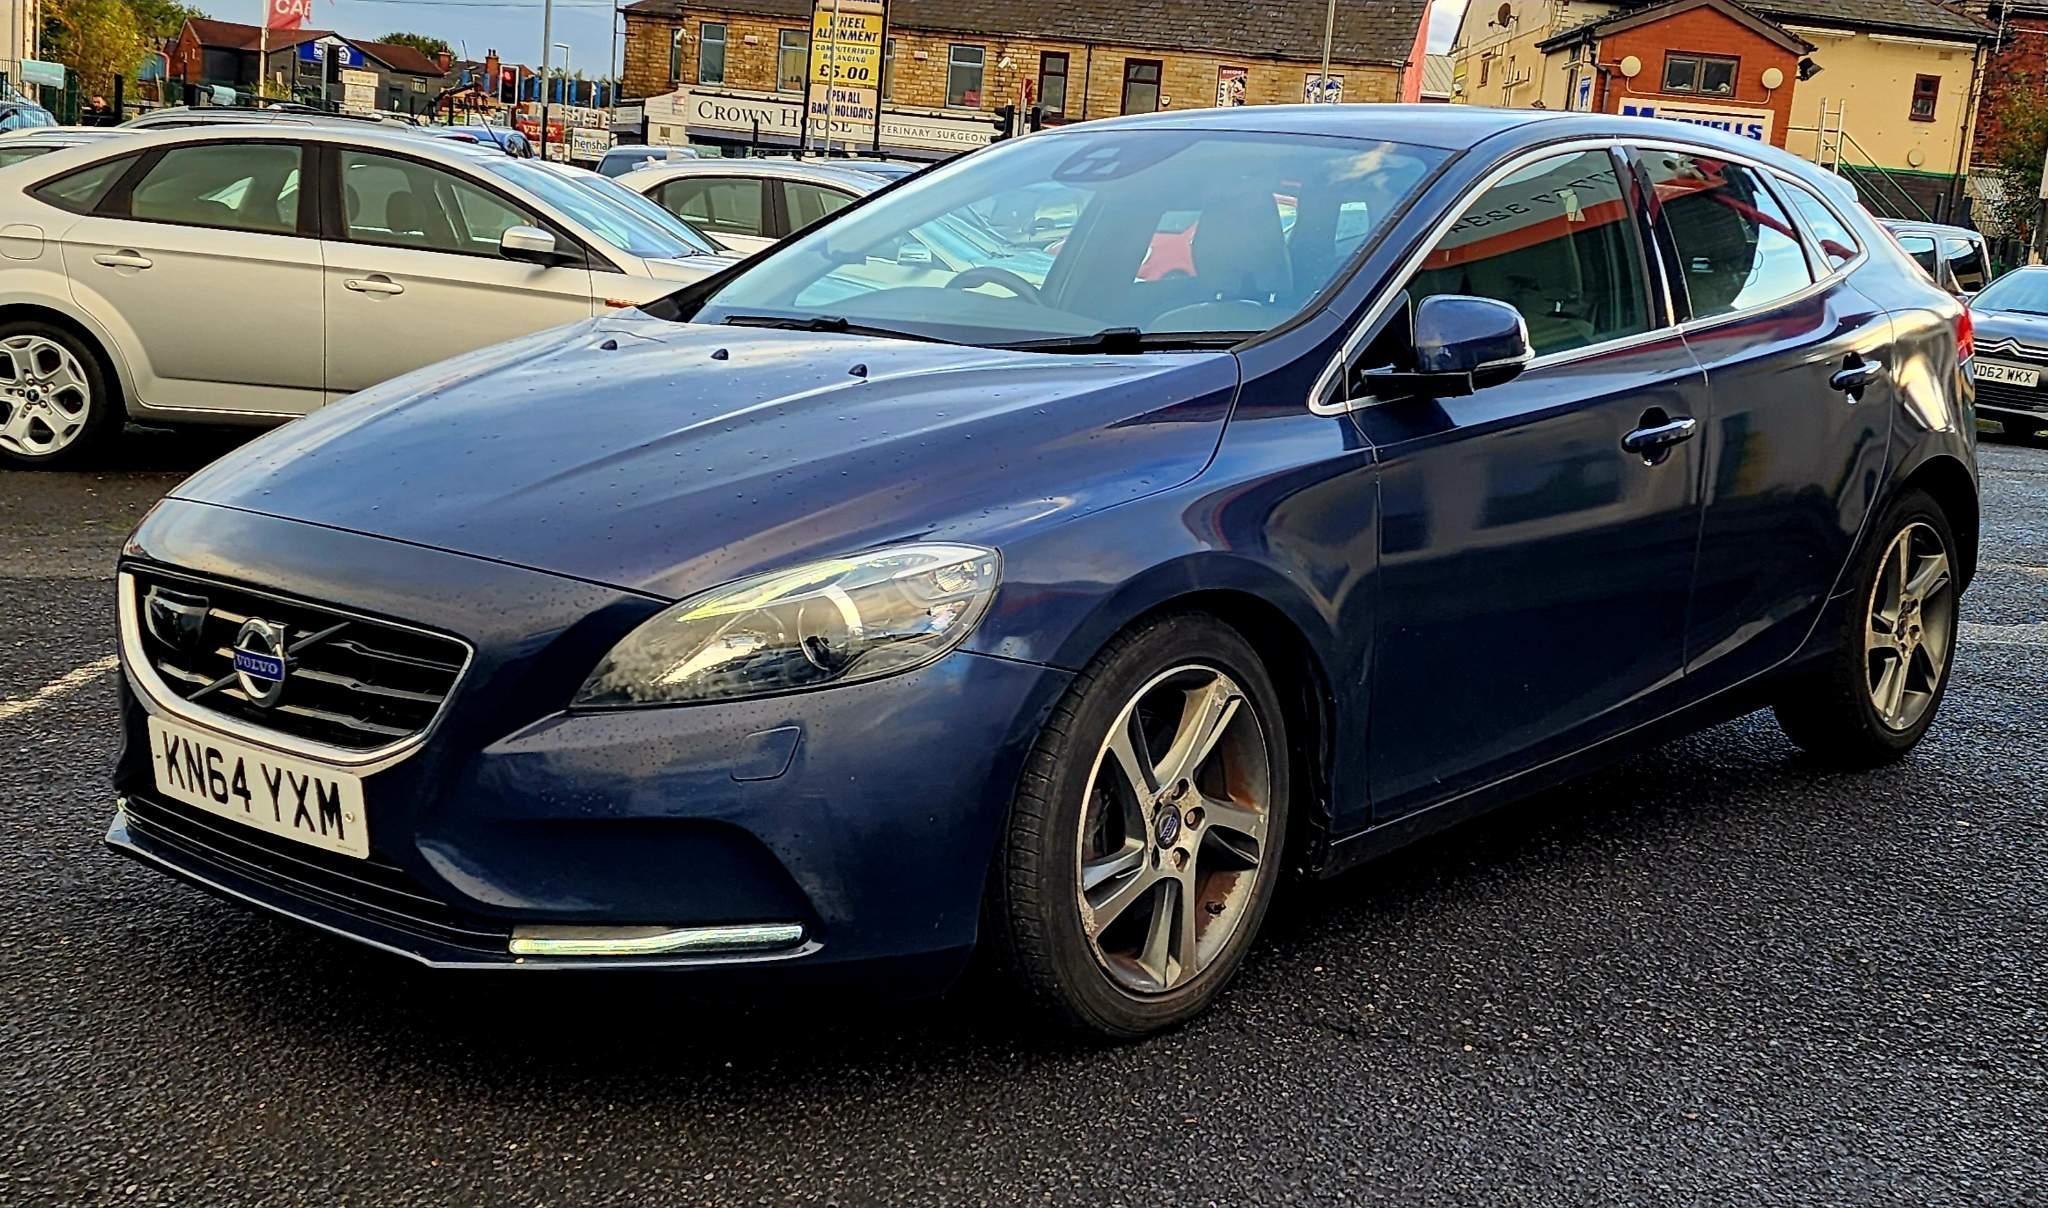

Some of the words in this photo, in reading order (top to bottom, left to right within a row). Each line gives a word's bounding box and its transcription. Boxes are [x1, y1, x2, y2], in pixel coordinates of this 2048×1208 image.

[815, 45, 875, 55] COMUTERISED
[823, 54, 866, 63] BANCING
[819, 64, 869, 80] £5.00
[848, 91, 861, 104] ALL
[698, 101, 773, 125] CROWN
[781, 108, 852, 133] HUSE
[812, 102, 834, 116] BAN
[835, 105, 873, 120] HOLIDAYS
[868, 125, 930, 137] VTERINARY
[2007, 369, 2033, 383] WKX
[236, 654, 278, 675] VOLVO
[162, 731, 252, 813] KN64
[260, 763, 345, 840] YXM
